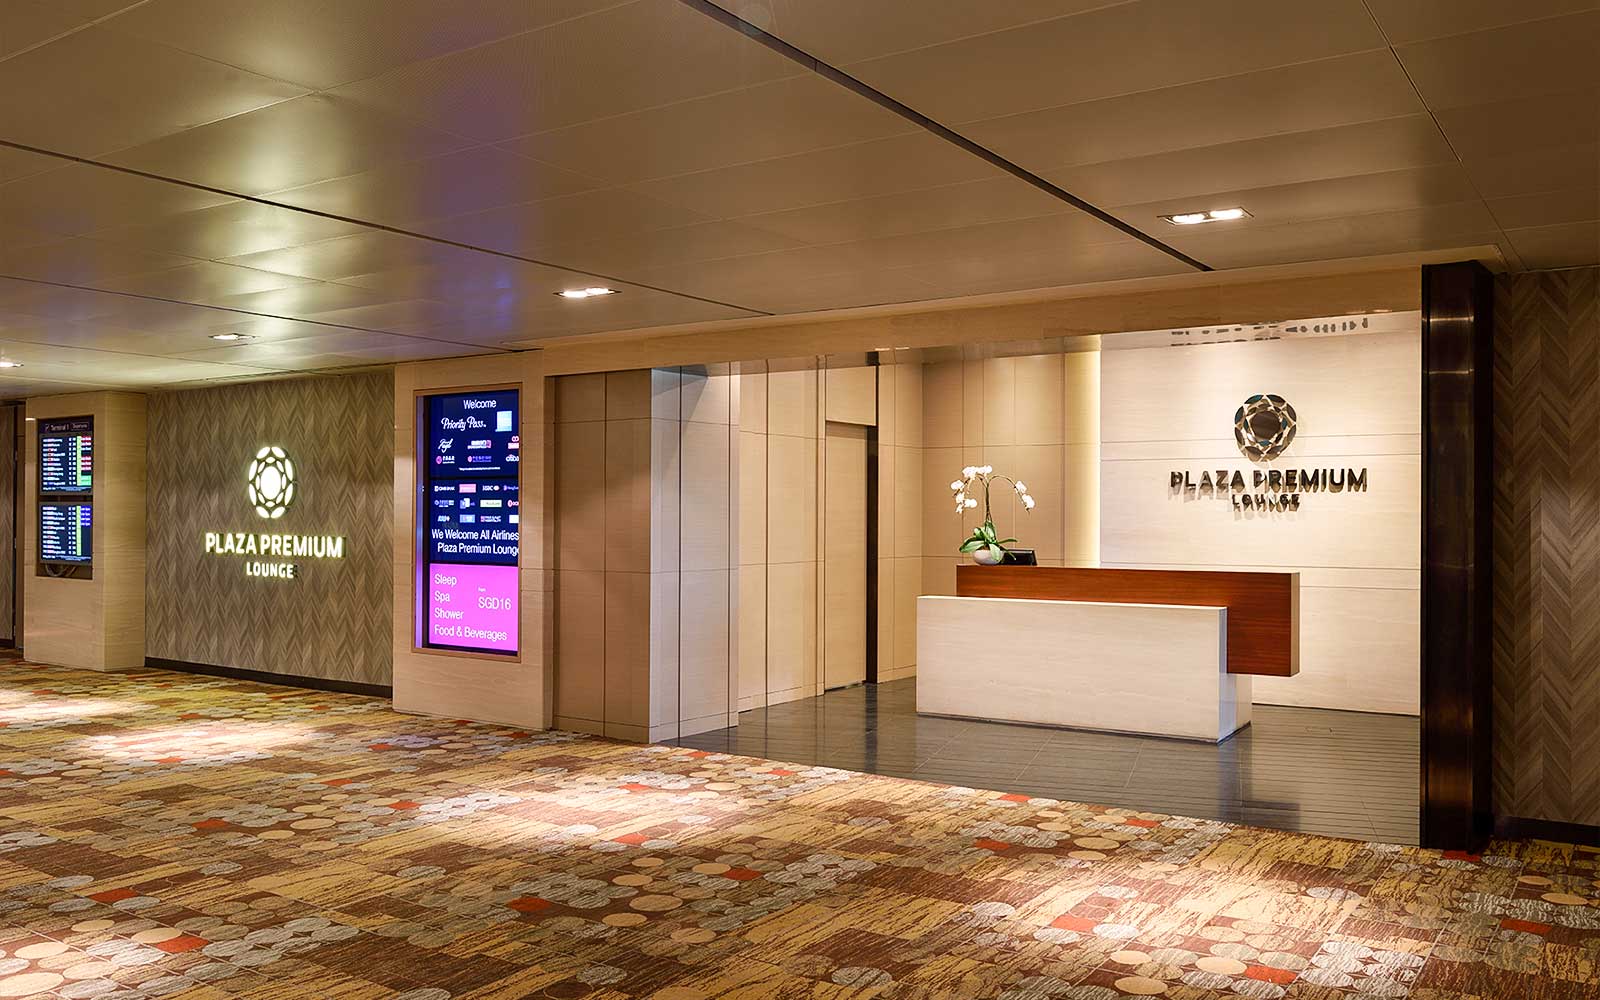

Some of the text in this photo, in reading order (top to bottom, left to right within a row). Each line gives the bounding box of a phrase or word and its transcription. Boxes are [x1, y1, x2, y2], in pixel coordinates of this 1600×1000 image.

[463, 400, 497, 409] Welcome
[441, 417, 466, 431] Priority
[1170, 468, 1368, 492] PLAZA PREMIUM
[1231, 493, 1300, 507] LOUNGE
[432, 529, 519, 540] We Welcome All Airlines
[206, 533, 343, 558] PLAZA PREMIUM
[438, 542, 457, 553] Plaza
[459, 543, 491, 554] Premium
[246, 562, 294, 578] LOUNGE
[434, 574, 457, 587] Sleep
[434, 590, 450, 604] Spa
[478, 597, 512, 610] SGD16
[434, 608, 464, 619] Shower
[434, 625, 507, 642] Food & Beverages
